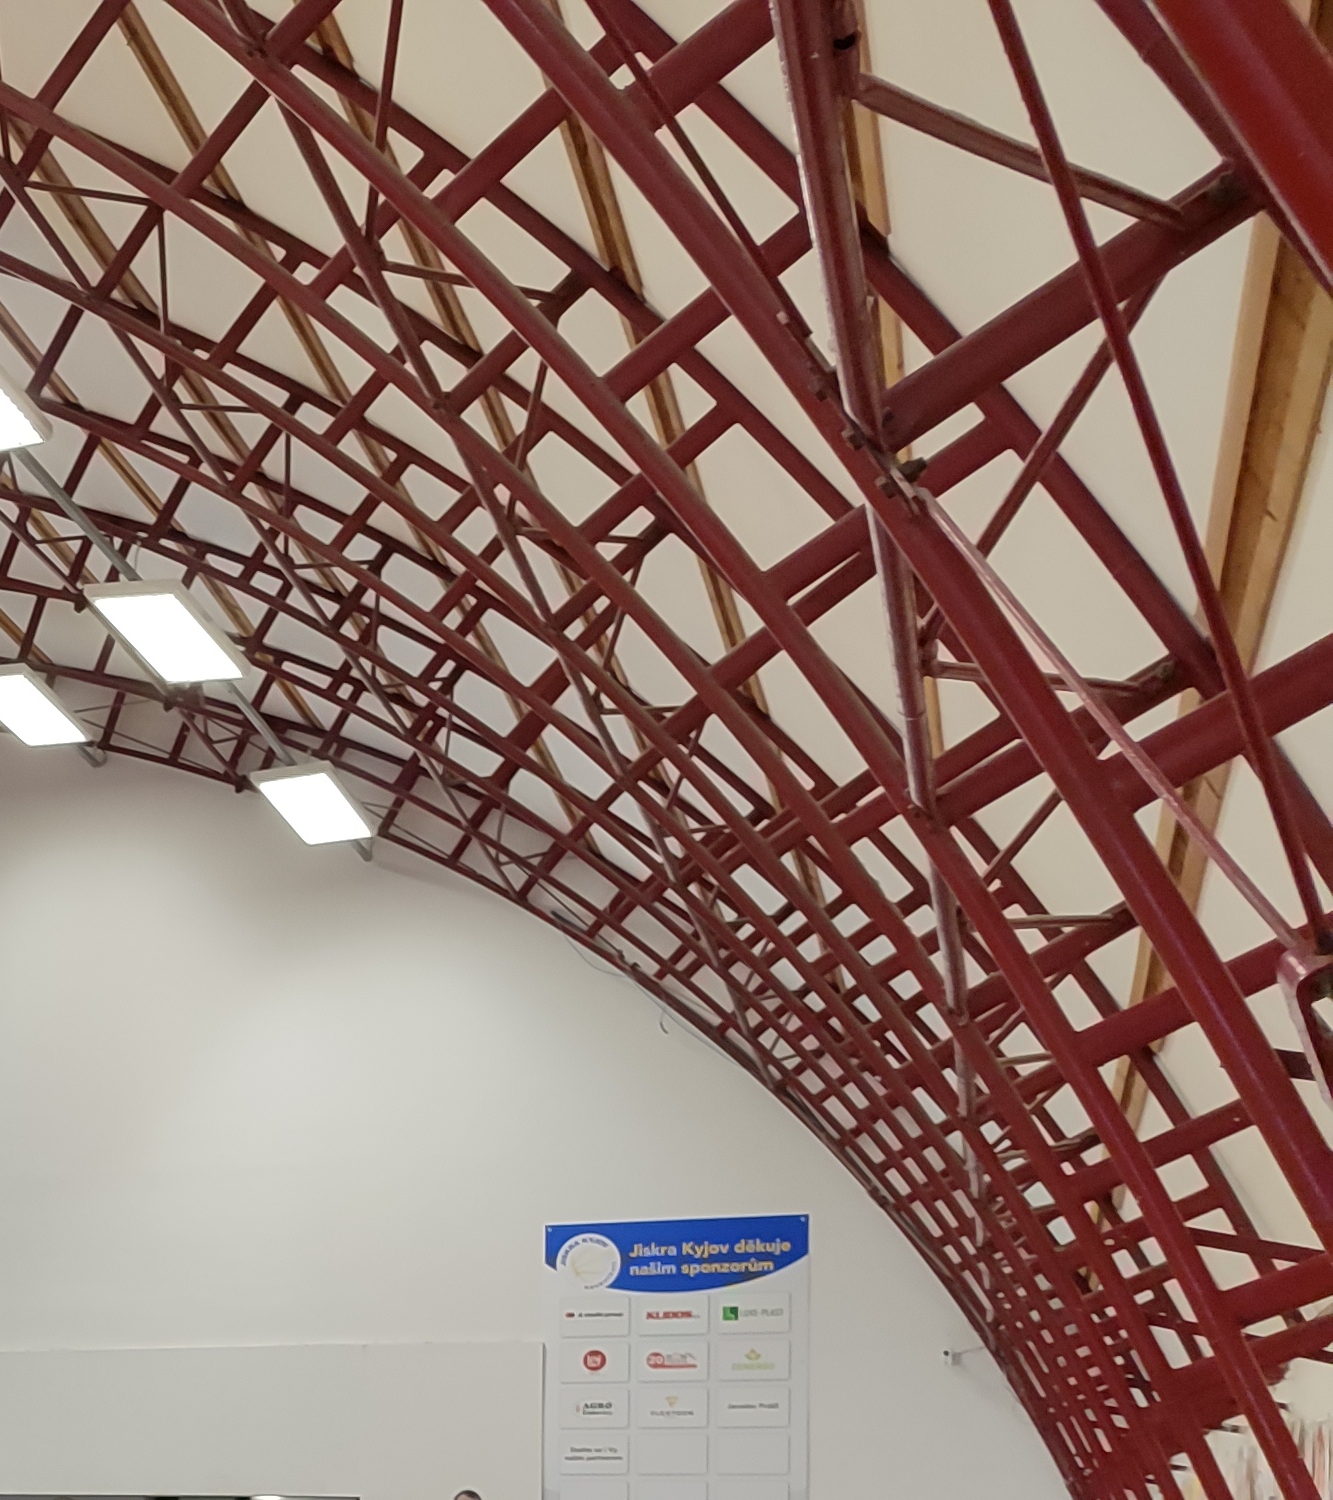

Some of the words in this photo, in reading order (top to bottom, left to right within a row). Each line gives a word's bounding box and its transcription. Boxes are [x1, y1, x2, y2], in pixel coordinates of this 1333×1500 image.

[629, 1242, 677, 1258] Jiskra
[682, 1240, 730, 1258] Kyjov
[734, 1237, 792, 1255] děkuje
[681, 1257, 775, 1277] sponzorům
